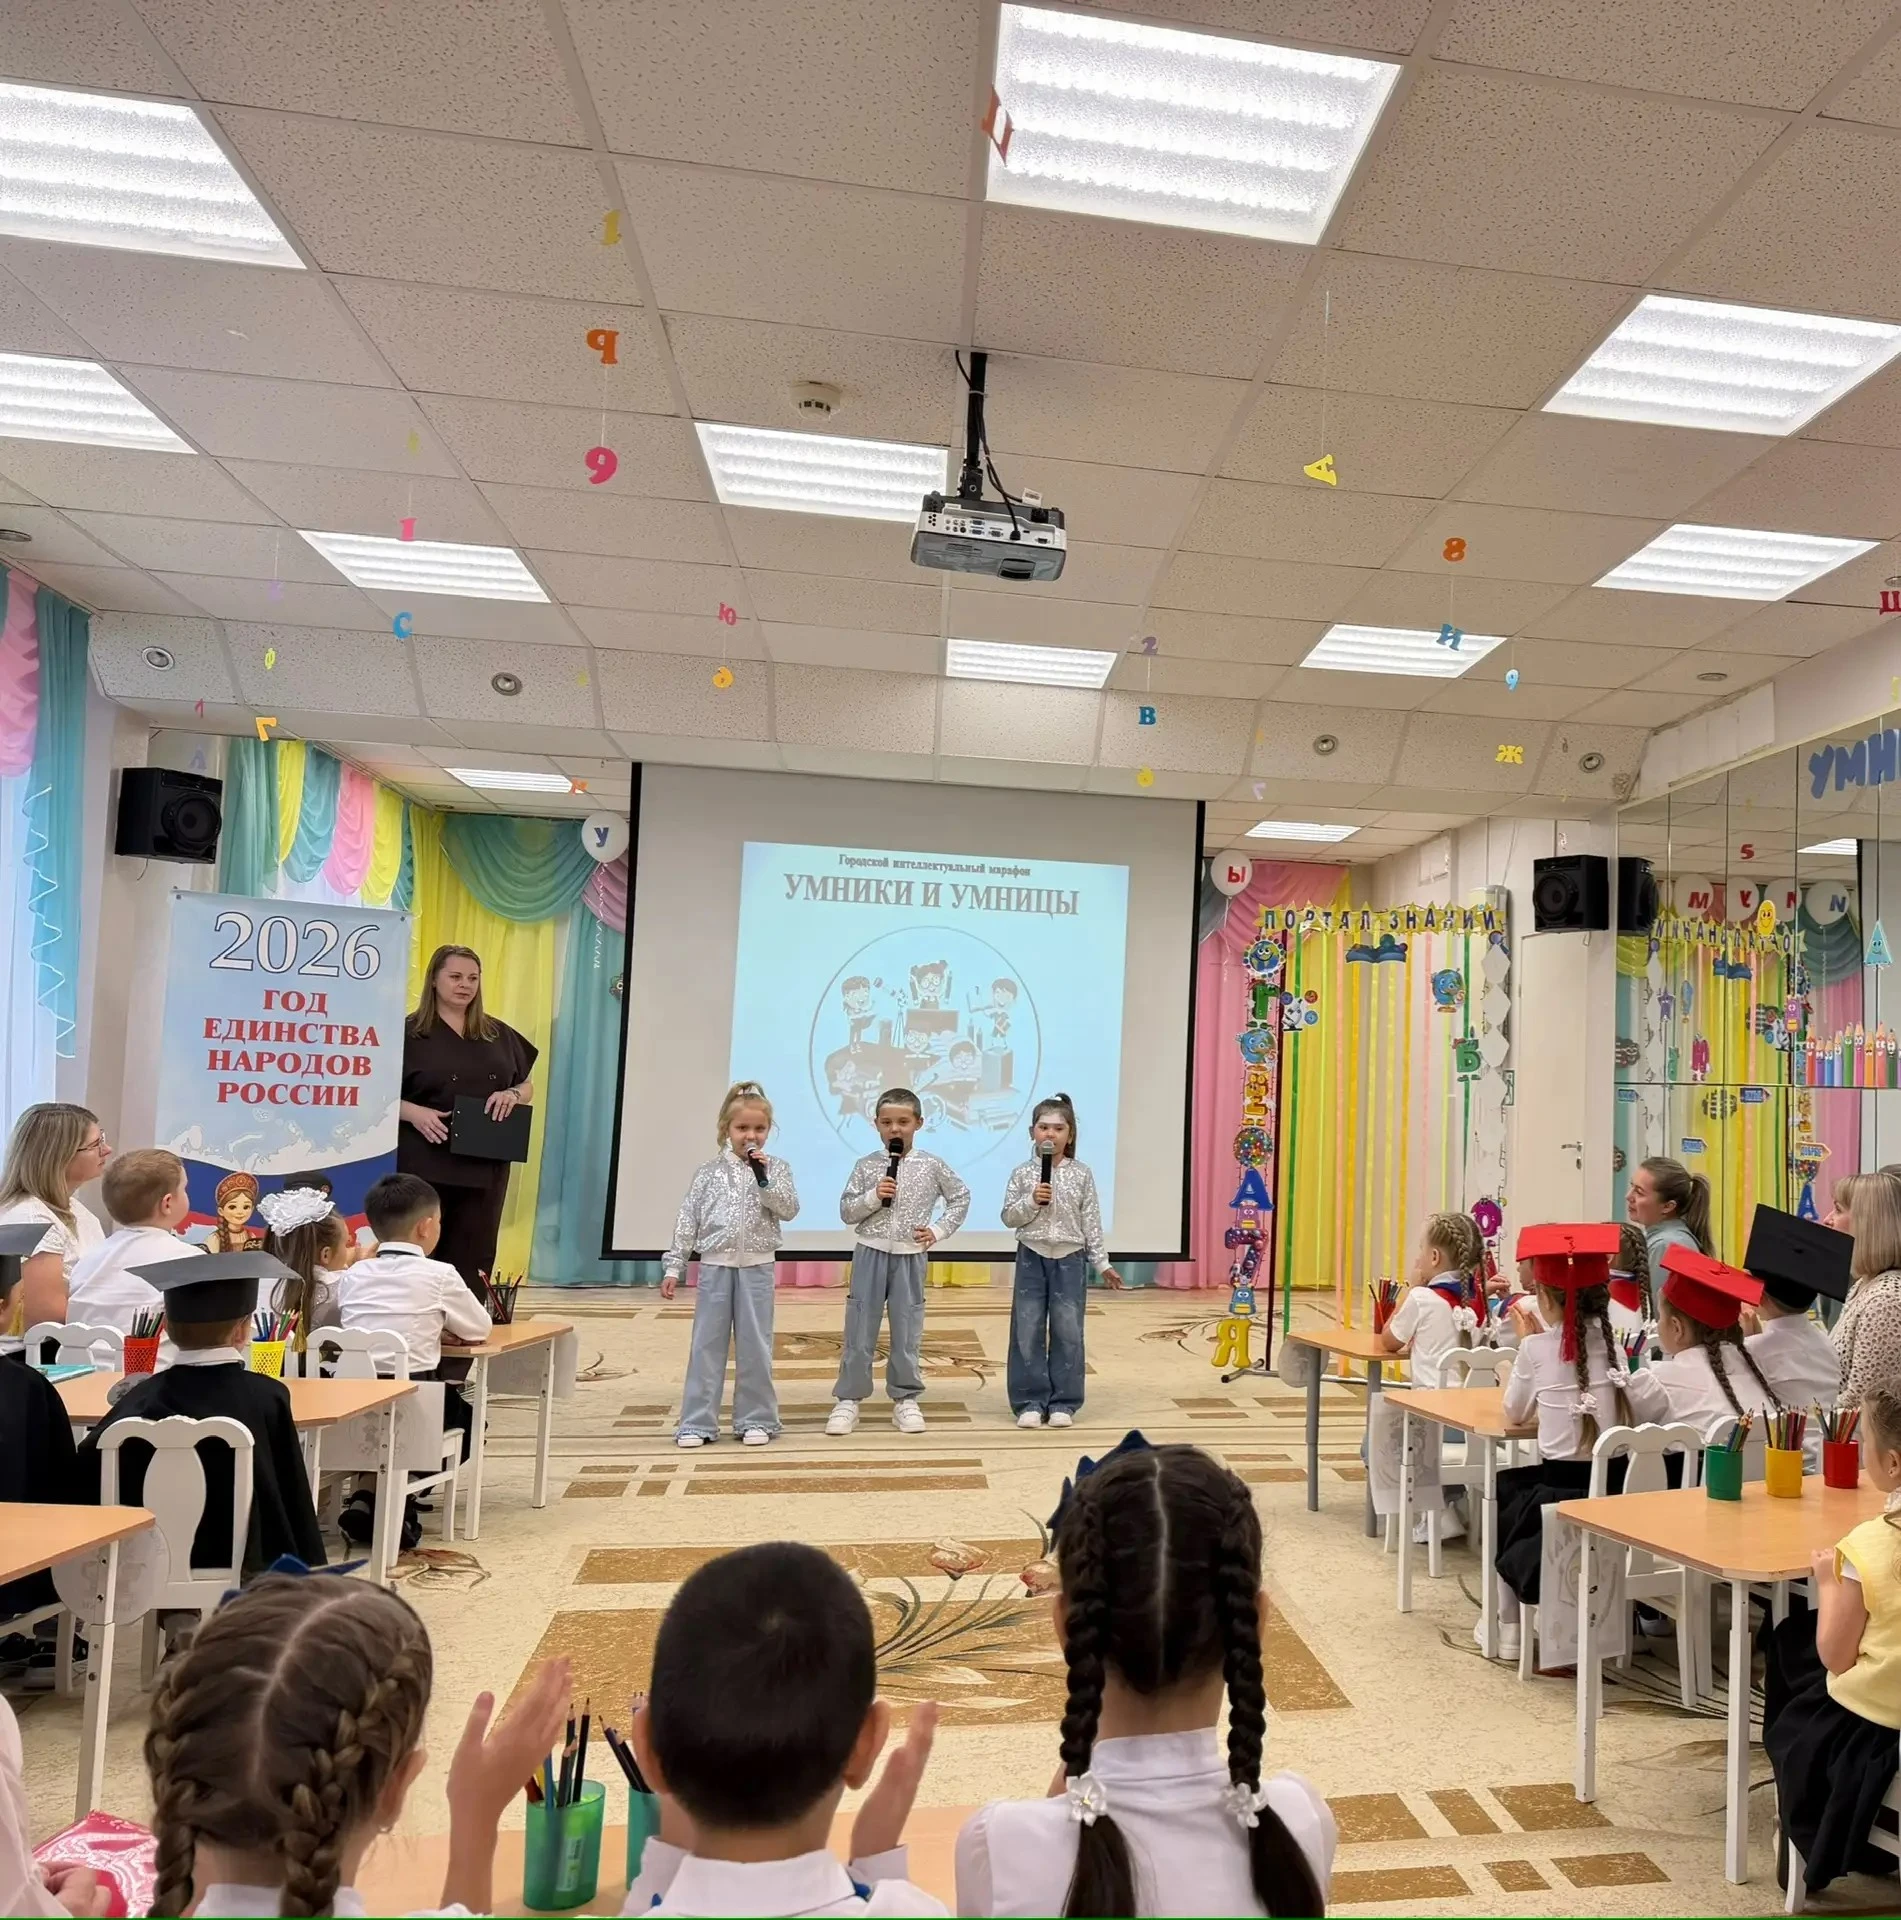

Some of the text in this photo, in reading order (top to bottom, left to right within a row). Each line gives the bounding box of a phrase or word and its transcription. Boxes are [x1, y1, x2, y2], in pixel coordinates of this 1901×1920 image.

[1442, 537, 1467, 562] 8
[1808, 729, 1901, 799] УМН
[838, 853, 889, 869] Городской
[989, 865, 1031, 878] марафон
[1227, 865, 1247, 884] Ы
[783, 873, 1080, 920] УМНИКИ И УМНИЦЫ
[209, 911, 381, 980] 2026
[262, 989, 329, 1018] ГОД
[203, 1017, 381, 1048] ЕДИНСТВА
[206, 1050, 373, 1079] НАРОДОВ
[216, 1081, 360, 1108] РОССИИ
[1211, 1318, 1252, 1368] Я
